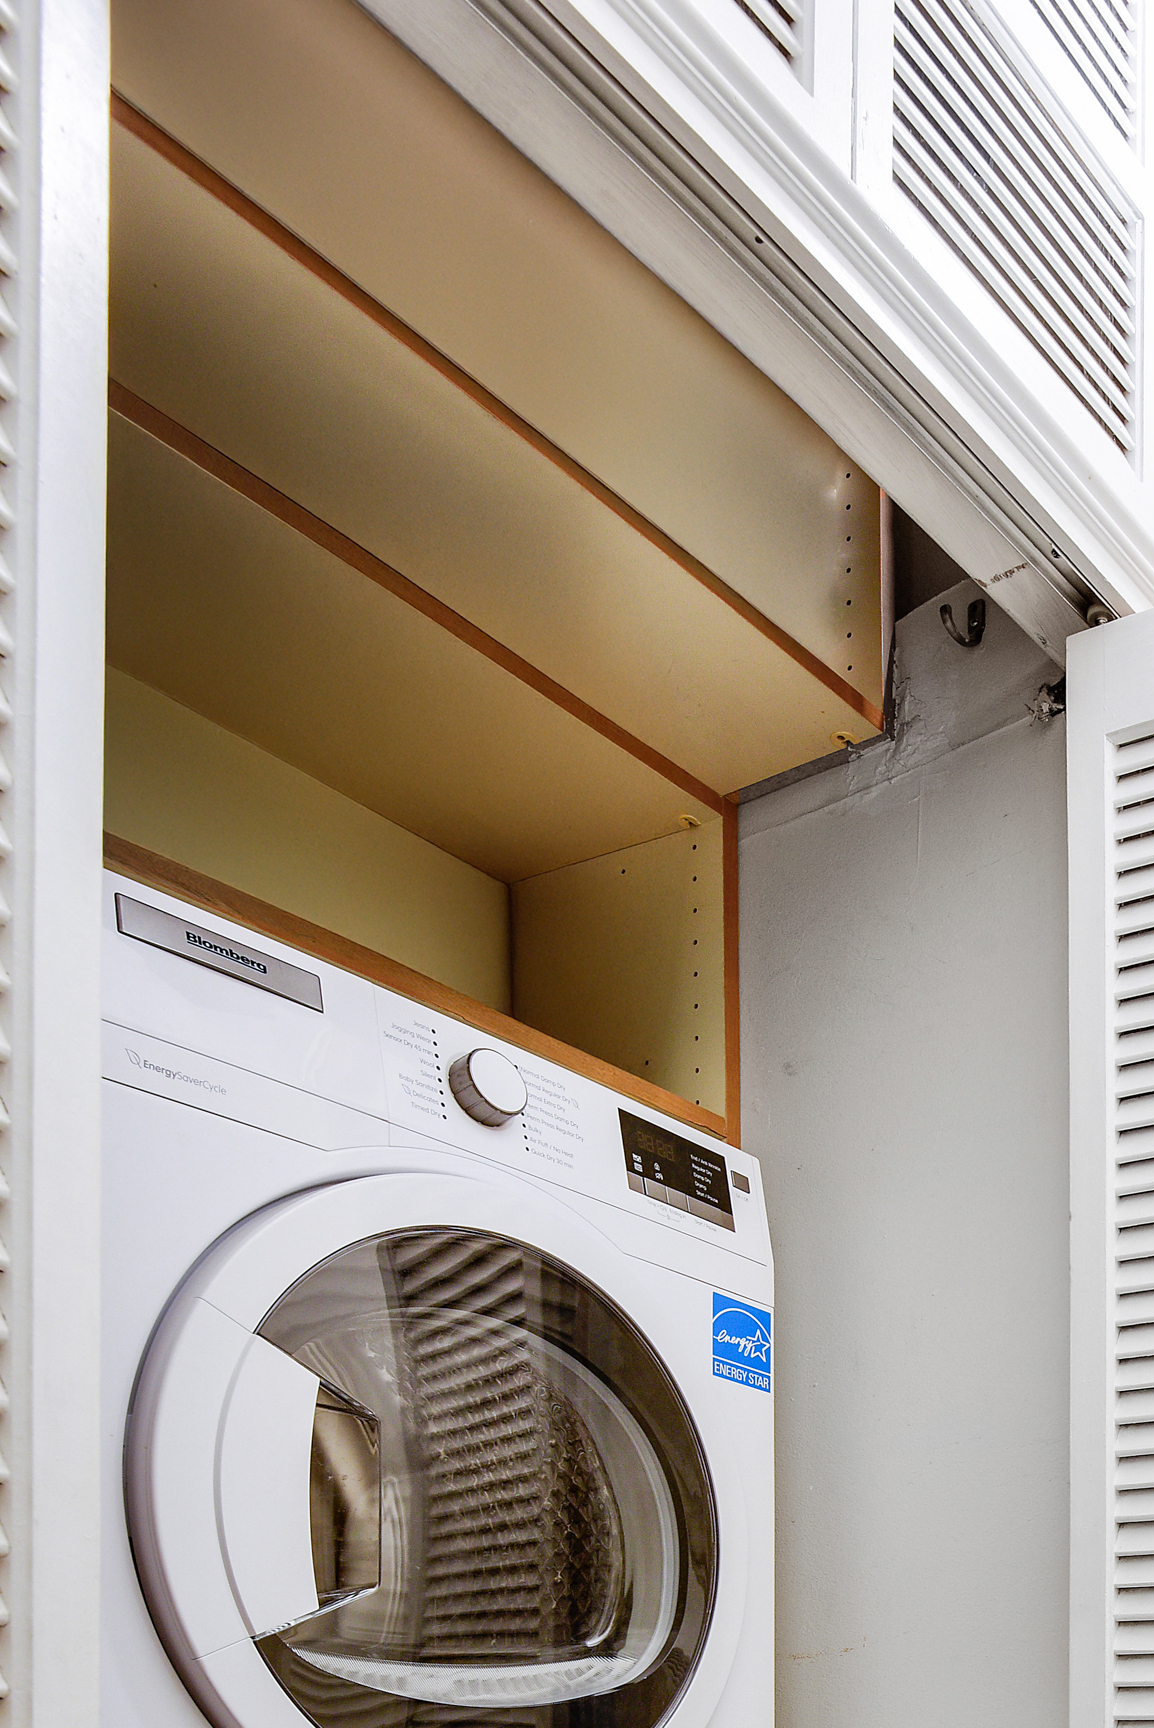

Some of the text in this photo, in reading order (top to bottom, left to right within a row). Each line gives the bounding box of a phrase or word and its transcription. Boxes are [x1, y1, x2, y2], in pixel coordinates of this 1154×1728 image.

[185, 930, 267, 974] Blomberg
[383, 1031, 433, 1056] Sensor Dry 45 min
[419, 1057, 435, 1068] Wool
[143, 1060, 227, 1095] EnergySaverCycle
[420, 1070, 437, 1081] Silent
[557, 1082, 565, 1091] Dry
[412, 1090, 439, 1106] Delicates
[528, 1092, 542, 1102] ormal
[557, 1104, 565, 1112] Dry
[562, 1096, 570, 1104] Dry
[411, 1101, 441, 1119] Timed Dry
[570, 1121, 579, 1129] Dry
[714, 1361, 769, 1389] ENERGY STAR
